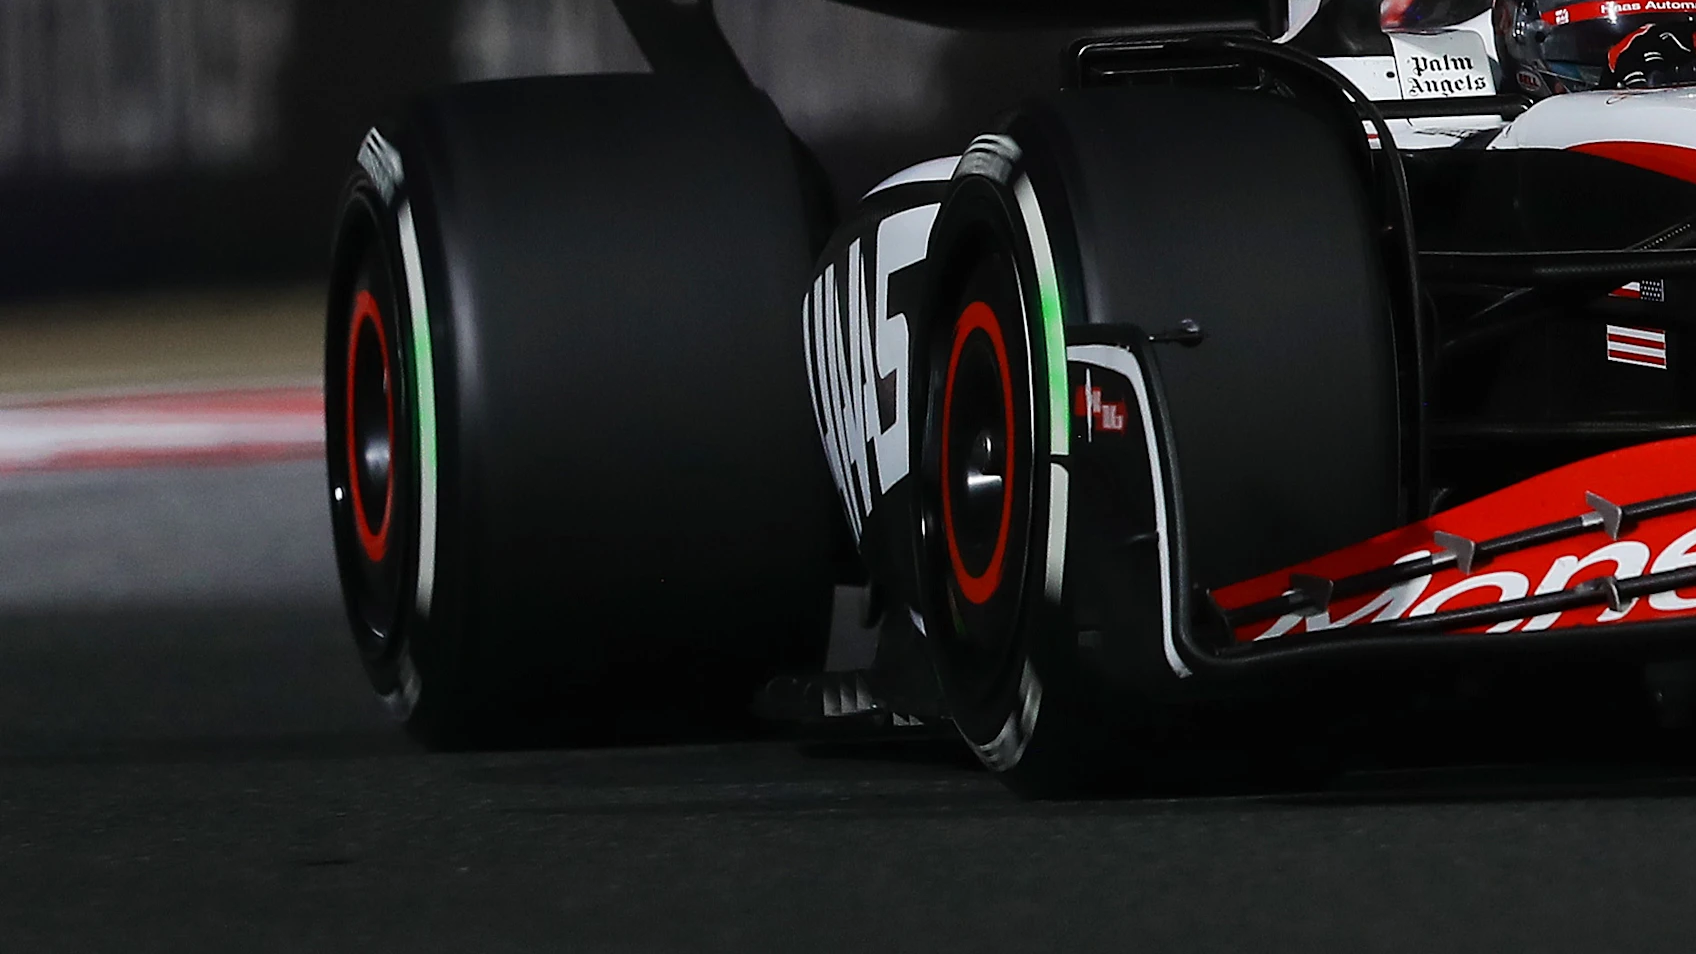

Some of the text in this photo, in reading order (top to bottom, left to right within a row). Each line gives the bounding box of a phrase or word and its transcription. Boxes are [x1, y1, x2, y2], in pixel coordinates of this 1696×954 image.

[1410, 54, 1474, 77] Palm
[1408, 74, 1487, 97] Angels
[802, 202, 942, 546] HAAS
